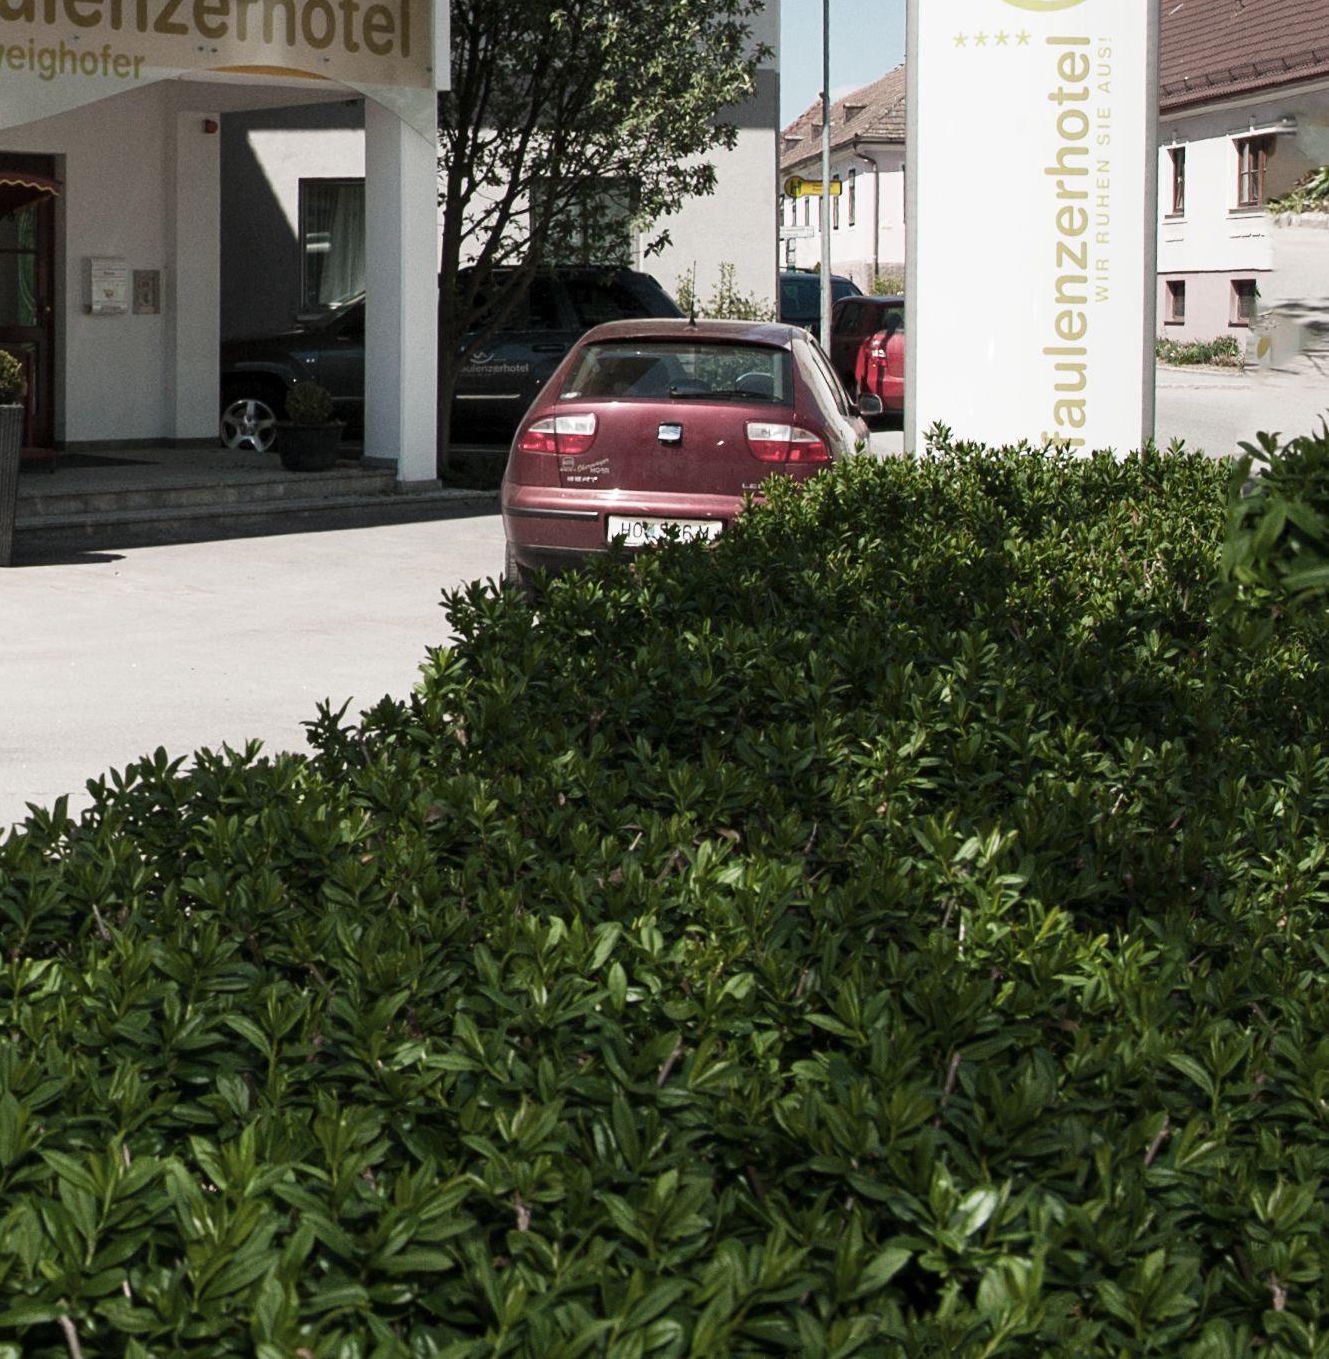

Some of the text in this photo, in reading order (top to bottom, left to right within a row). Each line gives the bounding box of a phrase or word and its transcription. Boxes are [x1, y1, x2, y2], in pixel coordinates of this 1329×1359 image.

[1095, 37, 1113, 303] WIR RUHEN SIE AUS!
[1040, 36, 1091, 447] faulenzerhotel
[459, 362, 529, 374] aulenzerhotel
[621, 521, 643, 538] HO
